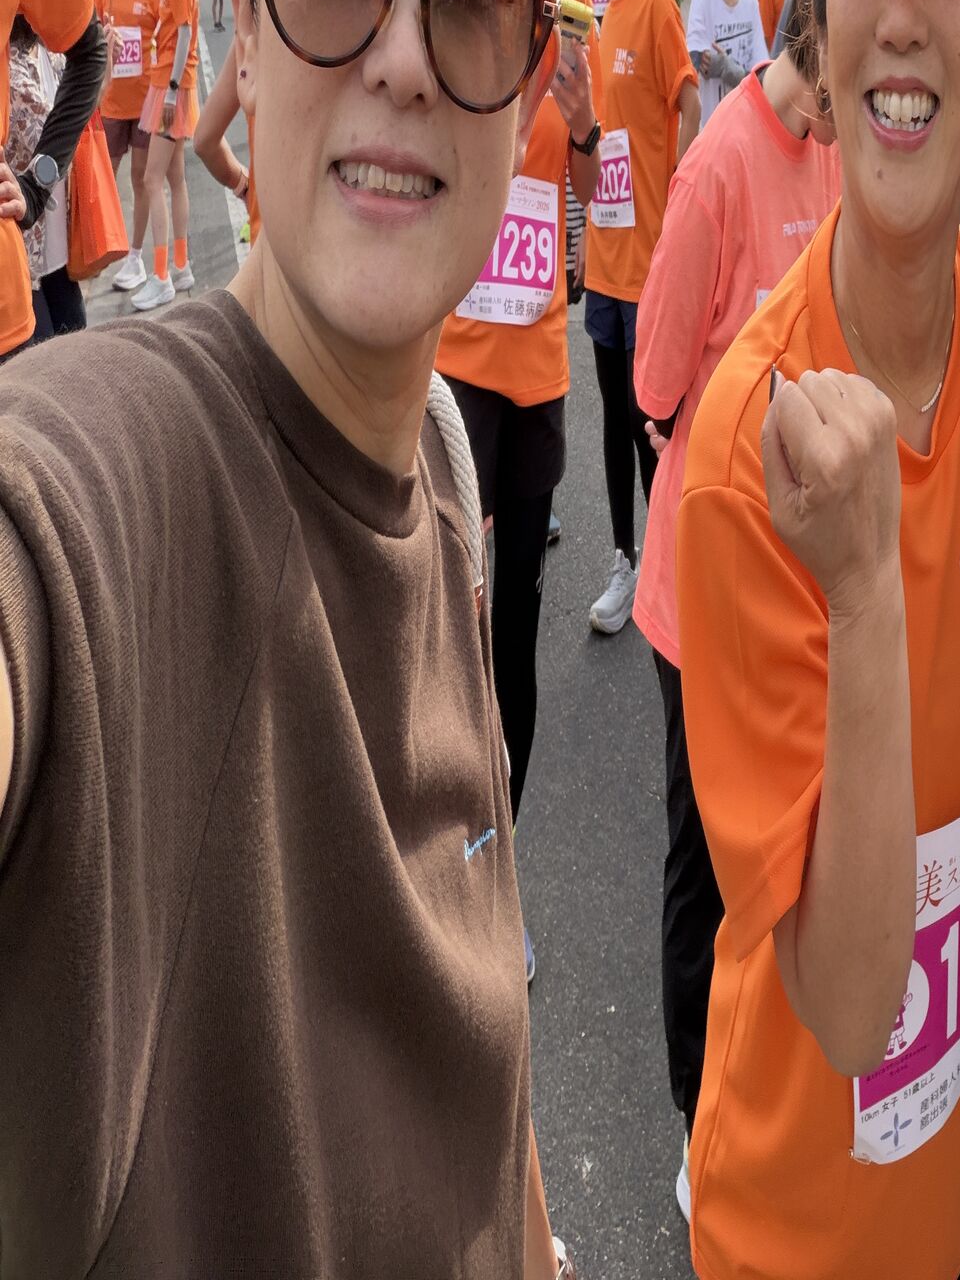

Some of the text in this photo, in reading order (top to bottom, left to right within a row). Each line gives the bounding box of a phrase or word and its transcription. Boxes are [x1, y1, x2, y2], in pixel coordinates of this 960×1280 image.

[116, 41, 141, 63] 329
[491, 220, 553, 283] 1239
[860, 1109, 880, 1125] 10km
[882, 1096, 899, 1113] 女子
